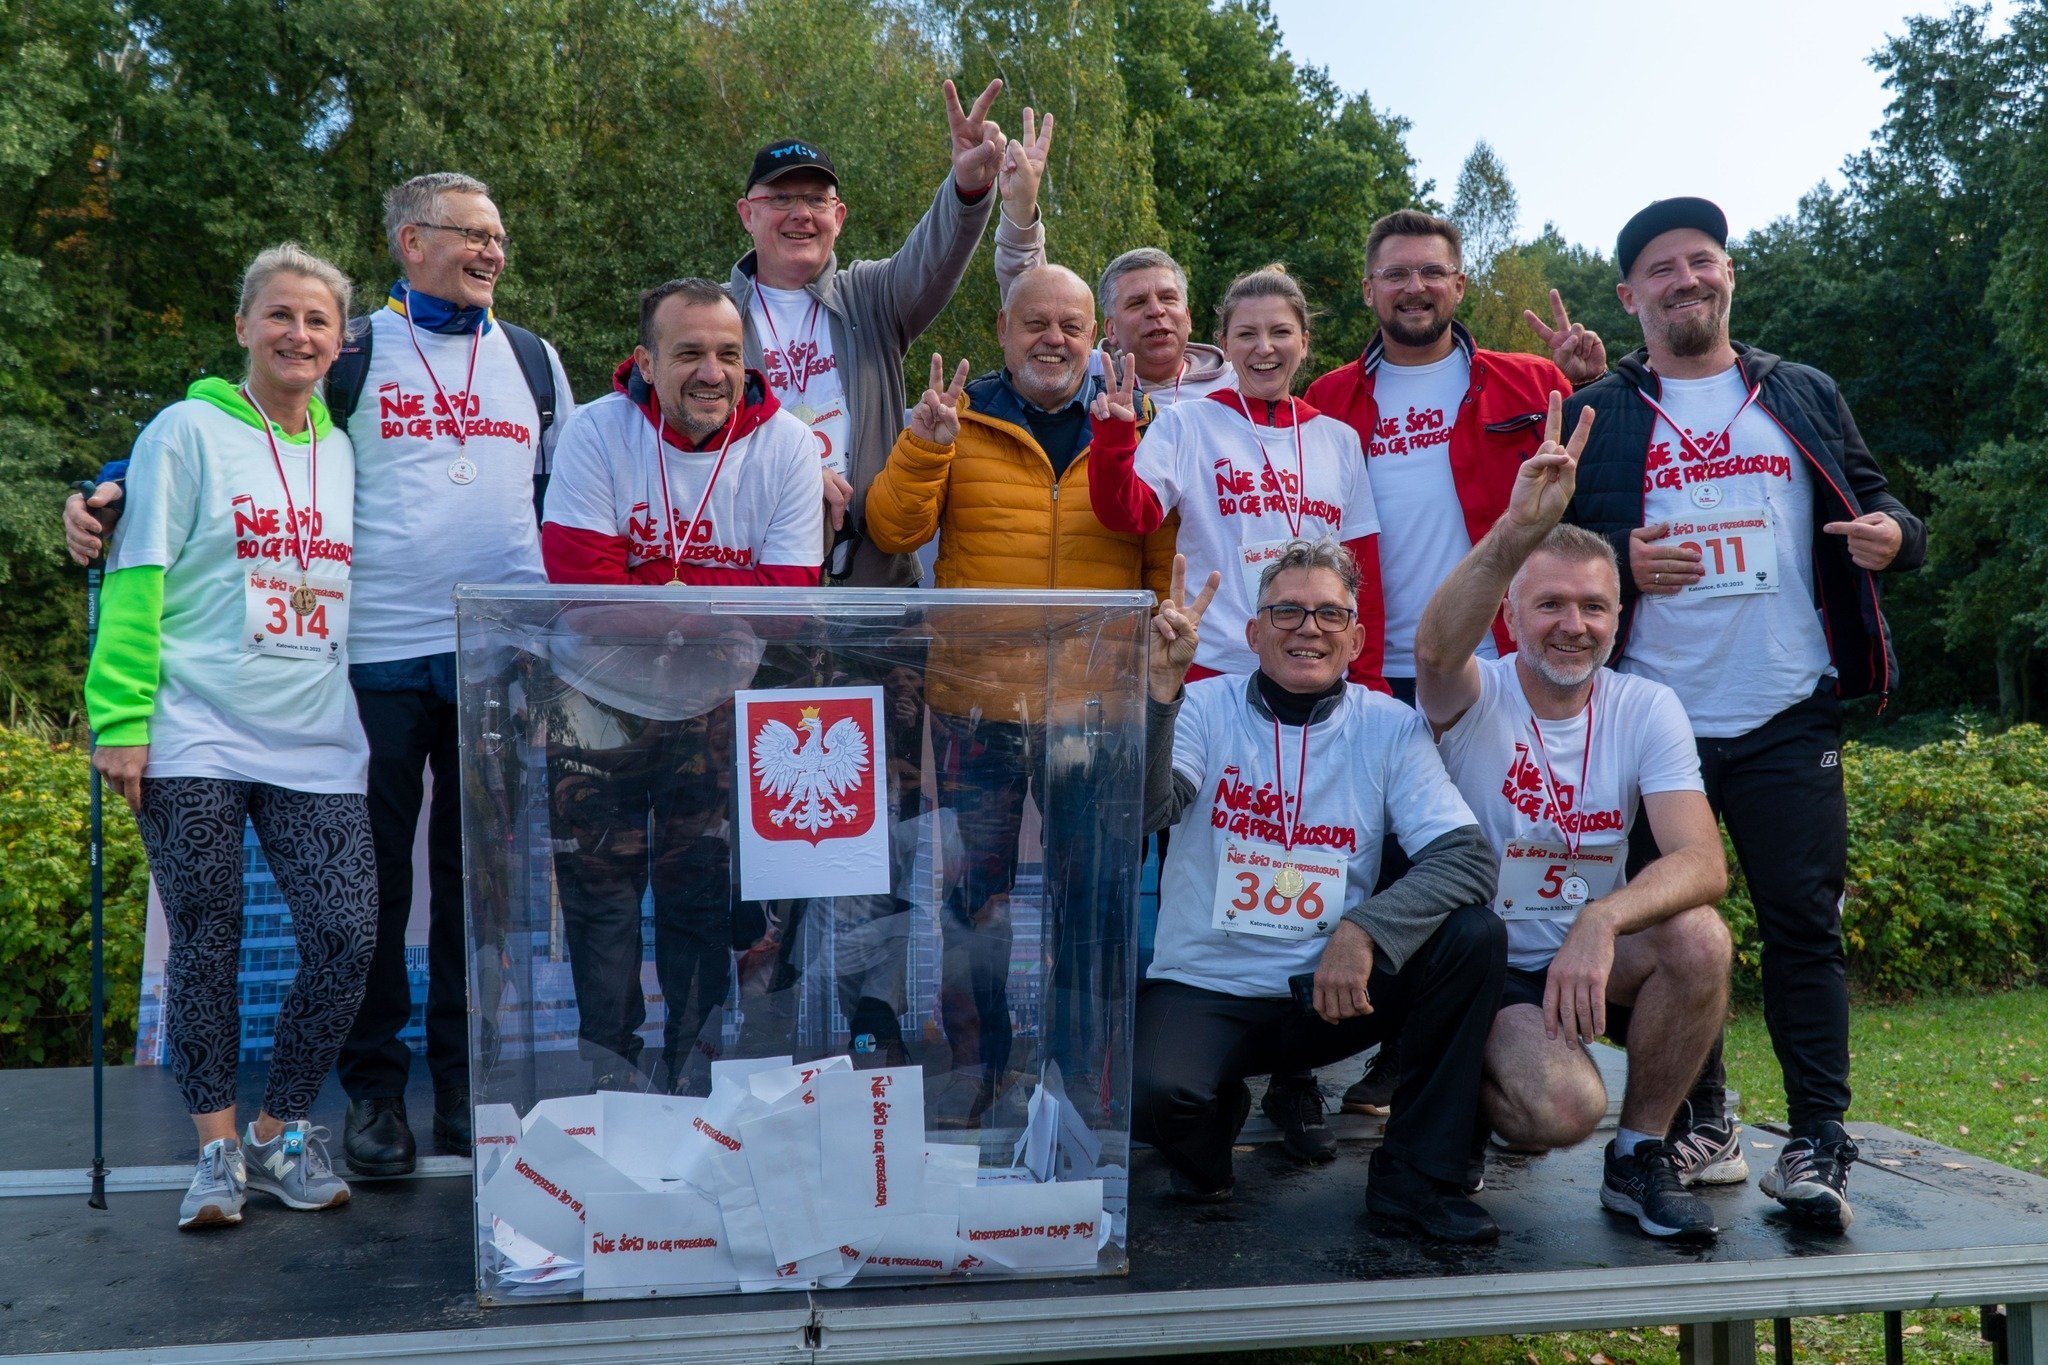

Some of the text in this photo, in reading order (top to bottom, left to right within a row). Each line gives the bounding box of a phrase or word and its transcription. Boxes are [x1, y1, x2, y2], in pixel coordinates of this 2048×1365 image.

[381, 421, 404, 439] BO
[1370, 442, 1386, 457] BO
[1218, 498, 1237, 517] BO
[236, 540, 259, 559] BO
[1678, 536, 1746, 578] 11
[265, 597, 329, 640] 314
[647, 1240, 658, 1251] BO
